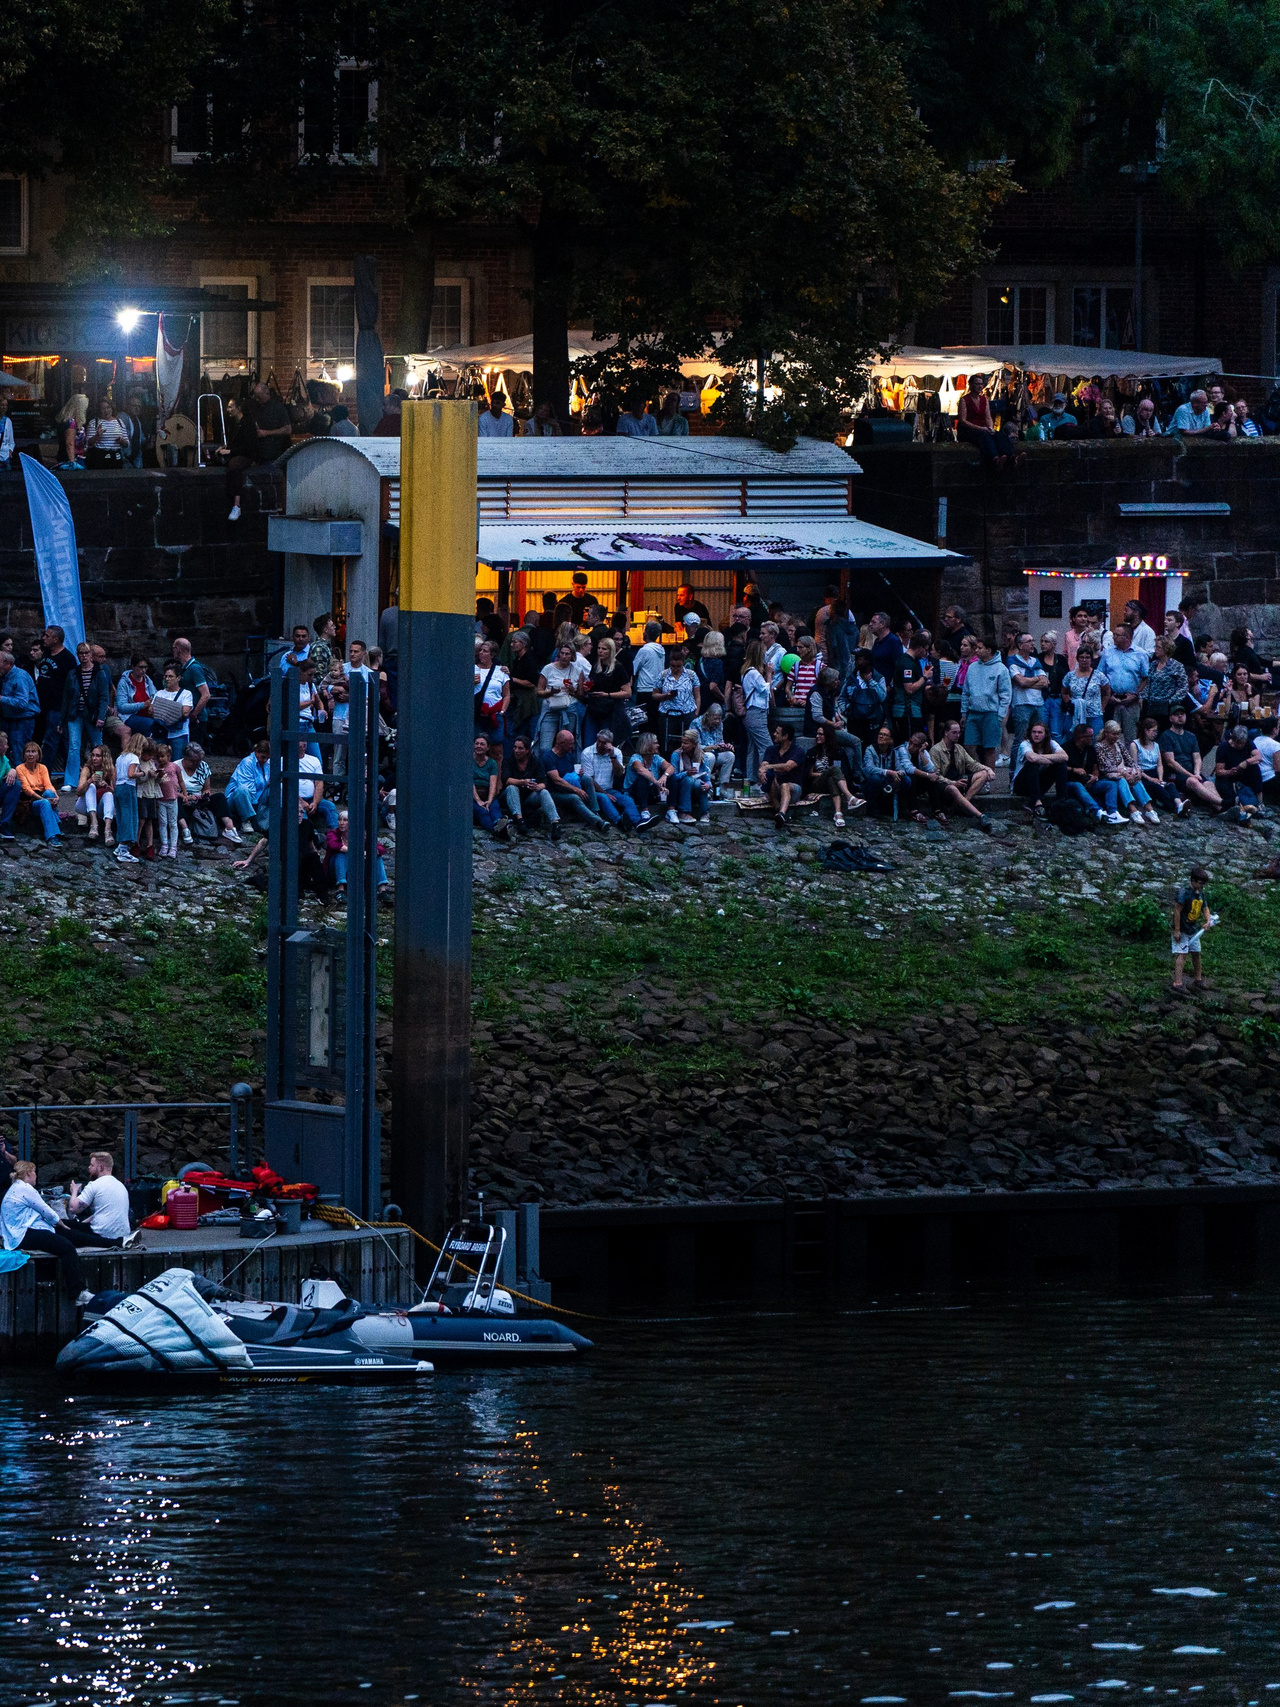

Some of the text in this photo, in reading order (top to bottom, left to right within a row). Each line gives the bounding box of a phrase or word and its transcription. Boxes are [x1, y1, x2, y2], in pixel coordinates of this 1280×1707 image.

[7, 321, 88, 346] KIOSK
[1114, 555, 1169, 571] FOTO
[483, 1332, 522, 1343] NOARD.
[361, 1357, 385, 1366] YAMAHA
